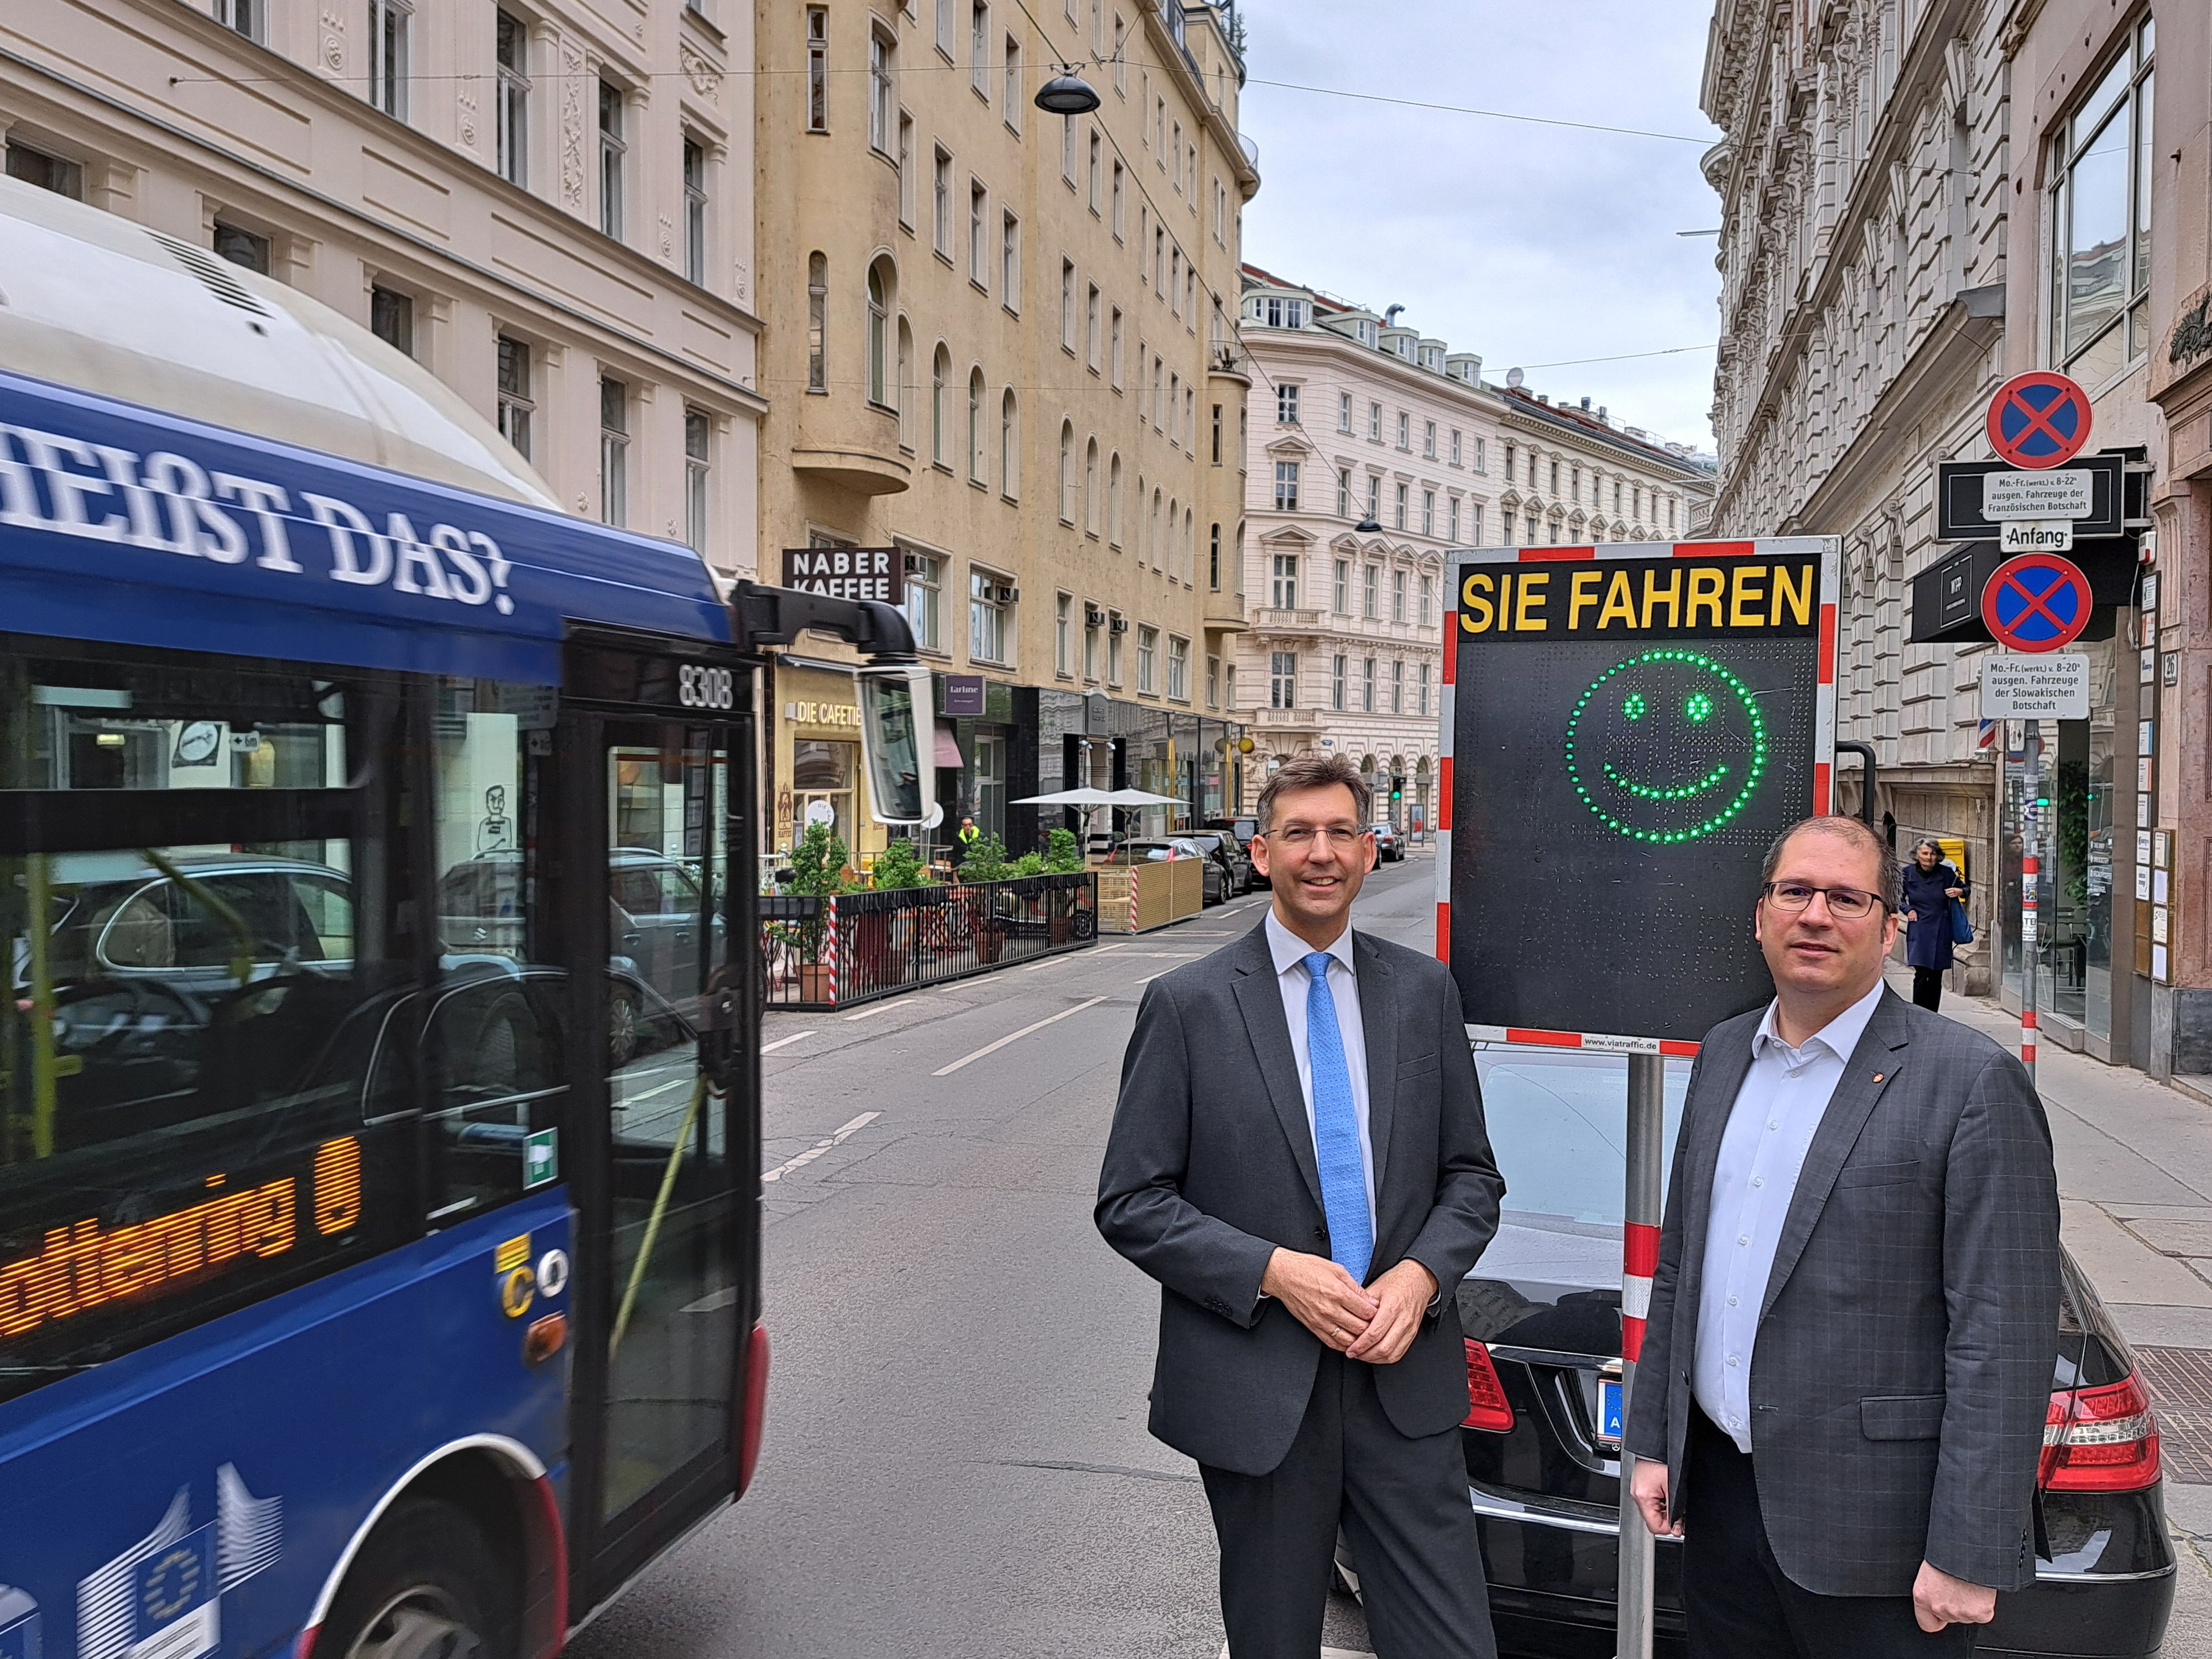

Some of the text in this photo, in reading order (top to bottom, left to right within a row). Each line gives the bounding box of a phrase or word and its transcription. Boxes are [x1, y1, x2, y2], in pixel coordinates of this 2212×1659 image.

[1992, 489, 2084, 501] ausgen. Fahrzeuge der
[1988, 502, 2087, 513] Französischen Botschaft
[2008, 527, 2064, 547] Anfang
[299, 491, 515, 616] DAS?
[793, 552, 890, 575] NABER
[1460, 565, 1813, 634] SIE FAHREN
[679, 664, 733, 709] 8308
[1992, 675, 2079, 687] ausgen. Fahrzeuge
[1995, 687, 2075, 697] der Slowakischen
[797, 701, 817, 723] DIE
[2012, 701, 2057, 710] Botschaft
[1584, 1038, 1657, 1050] www.viatraffic.de
[1610, 1416, 1621, 1430] A
